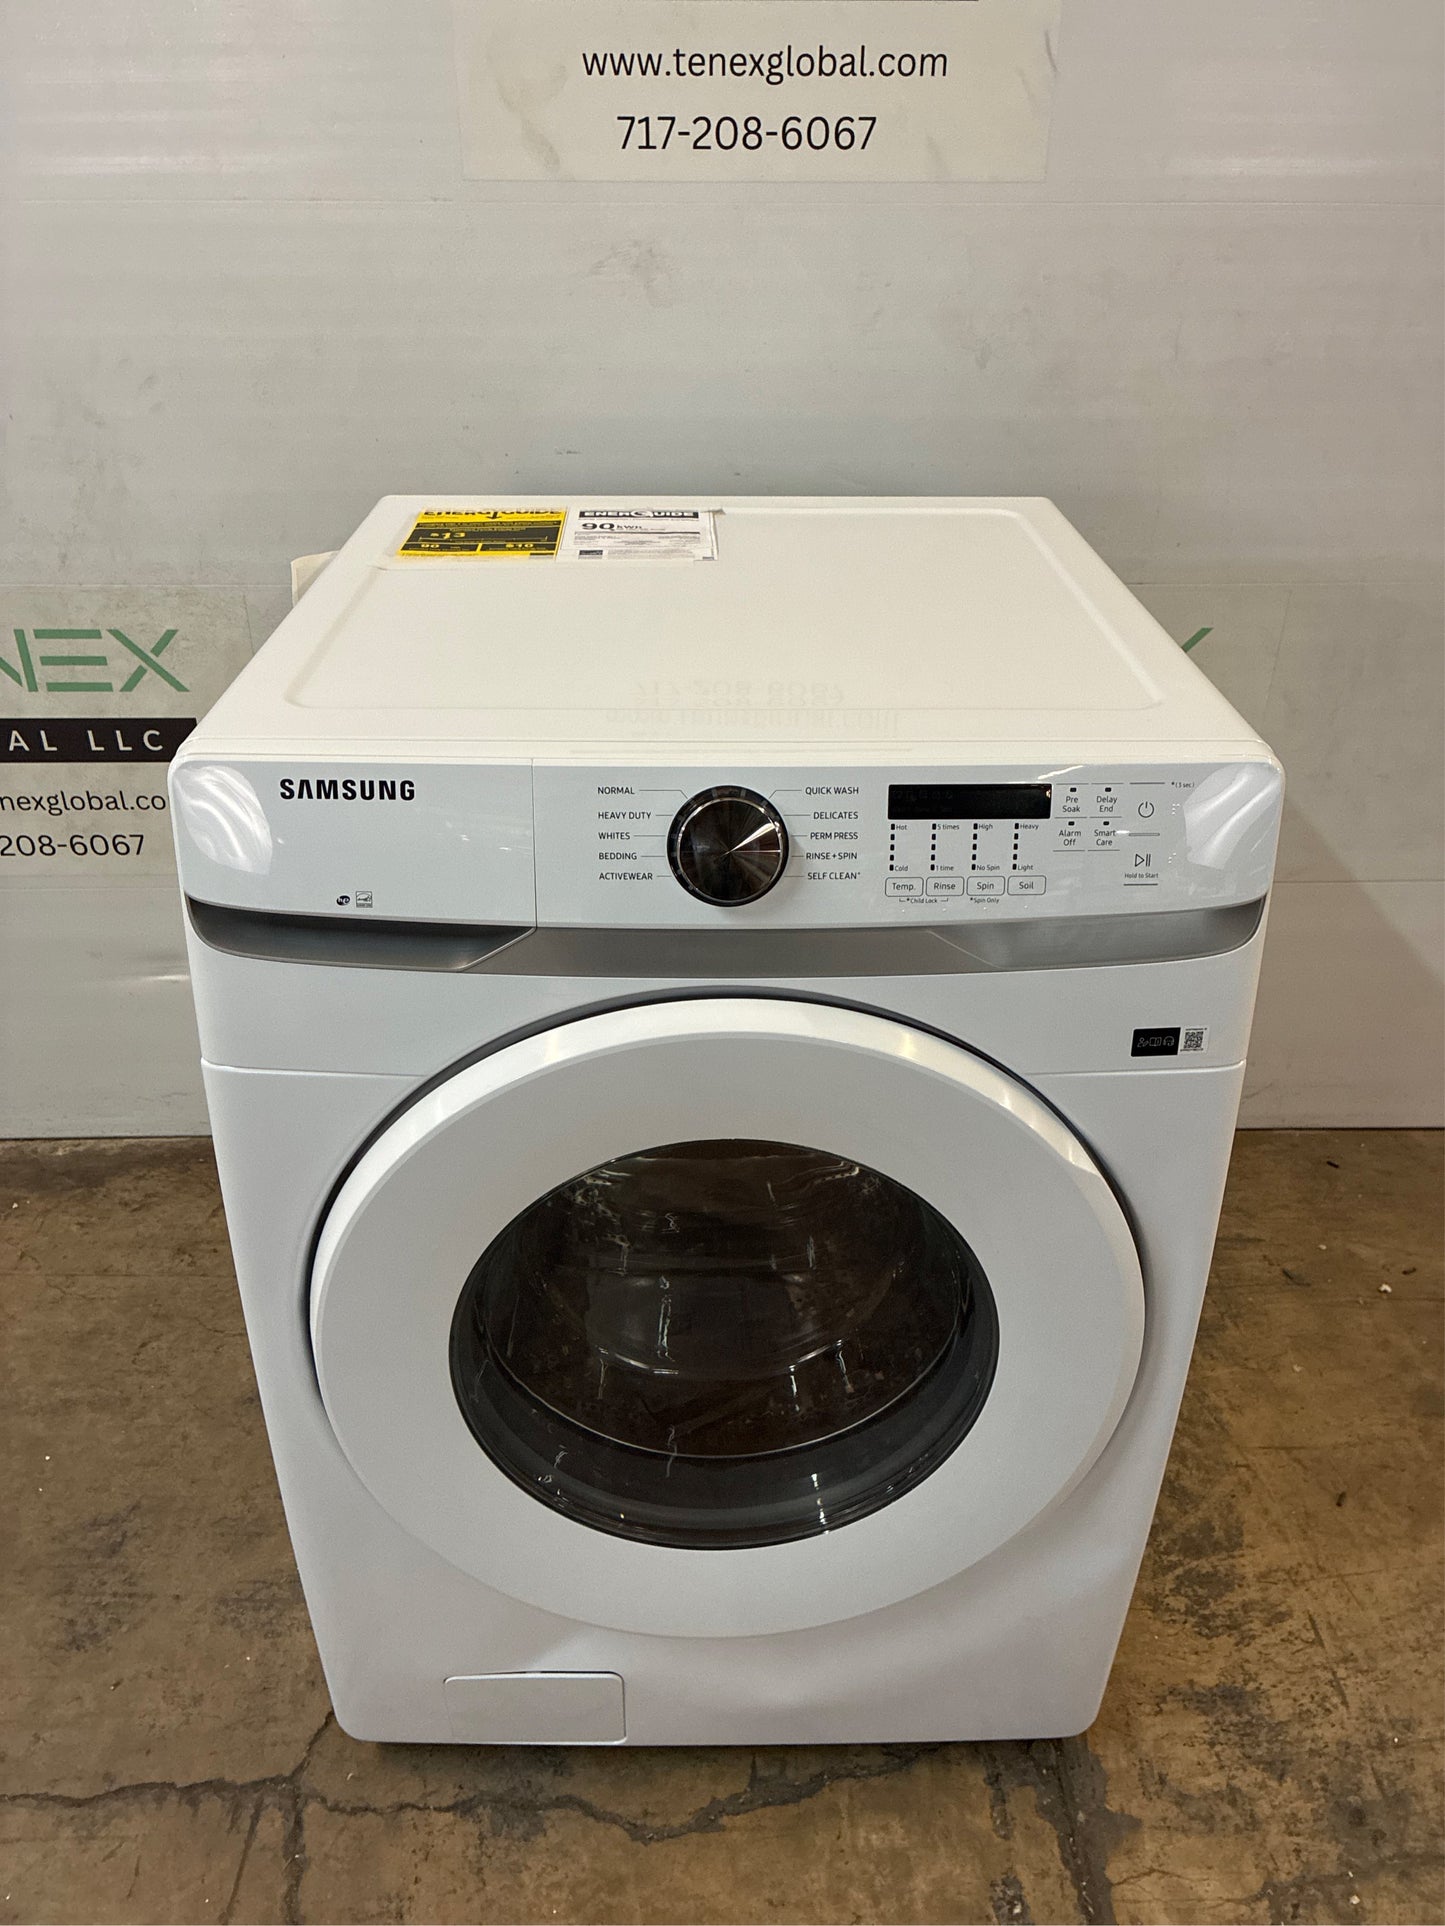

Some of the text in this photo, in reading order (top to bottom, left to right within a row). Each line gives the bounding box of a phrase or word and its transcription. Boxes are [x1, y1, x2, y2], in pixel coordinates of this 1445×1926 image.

[582, 45, 948, 84] www.tenexglobal.com
[616, 116, 877, 150] 717-208-6067
[9, 730, 163, 751] AL LLC
[280, 779, 415, 800] SAMSUNG
[805, 786, 832, 795] QUICK
[1096, 796, 1117, 804] Delay
[1062, 805, 1080, 813] Soak
[598, 811, 651, 819] HEAVY DUTY
[813, 811, 858, 819] DELICATES
[598, 832, 630, 840] WHITES
[810, 832, 858, 840] PERM PRESS
[1059, 829, 1081, 837] Alarm
[1094, 829, 1116, 837] Smart
[0, 834, 144, 856] 208-6067
[1063, 838, 1076, 846] Off
[1096, 838, 1113, 846] Care
[599, 852, 637, 860] BEDDING
[599, 872, 653, 880] ACTIVEWEAR
[807, 871, 827, 880] SELF
[892, 882, 916, 891] Temp.
[934, 882, 956, 890] Rinse
[977, 881, 994, 891] Spin
[1019, 881, 1034, 889] Soil
